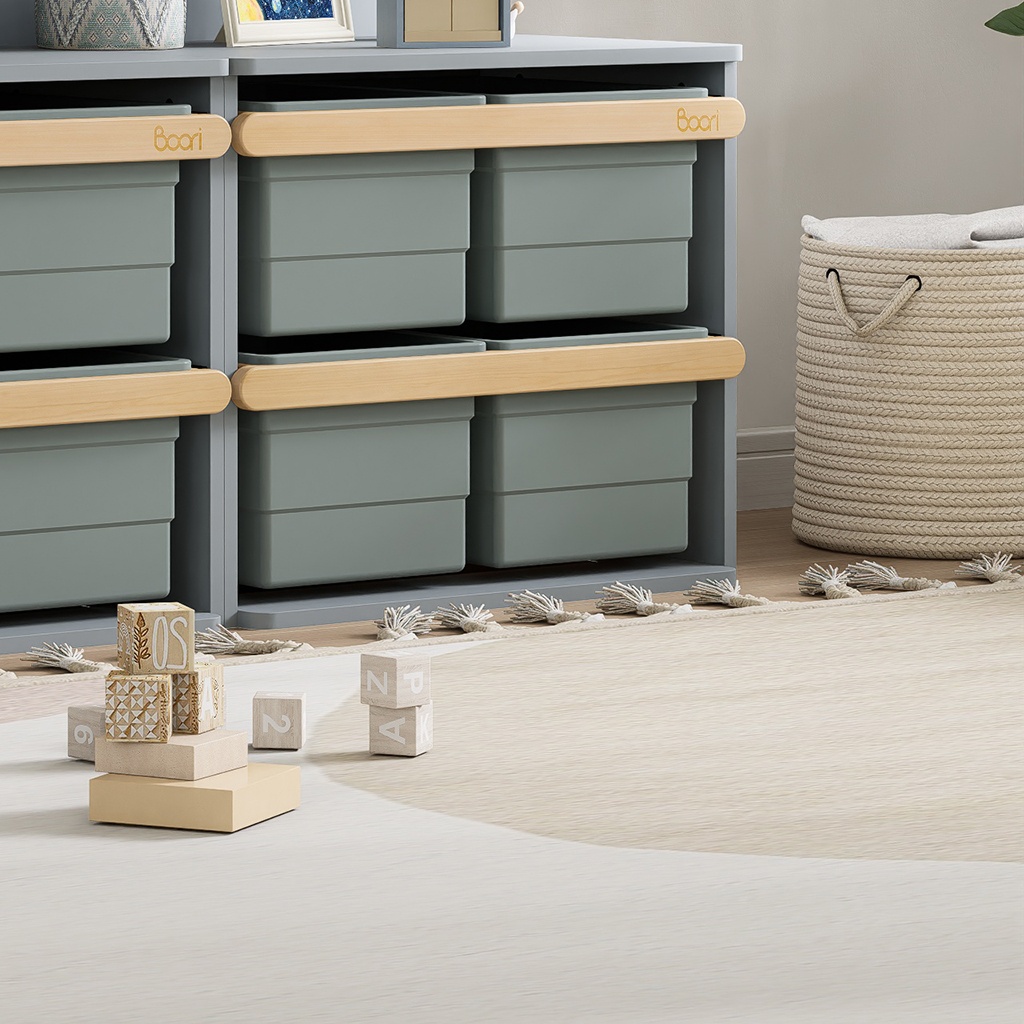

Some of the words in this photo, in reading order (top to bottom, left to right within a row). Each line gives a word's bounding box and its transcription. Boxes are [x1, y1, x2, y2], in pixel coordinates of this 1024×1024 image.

[677, 106, 719, 133] Boori
[153, 125, 203, 152] Boori
[378, 716, 406, 745] A
